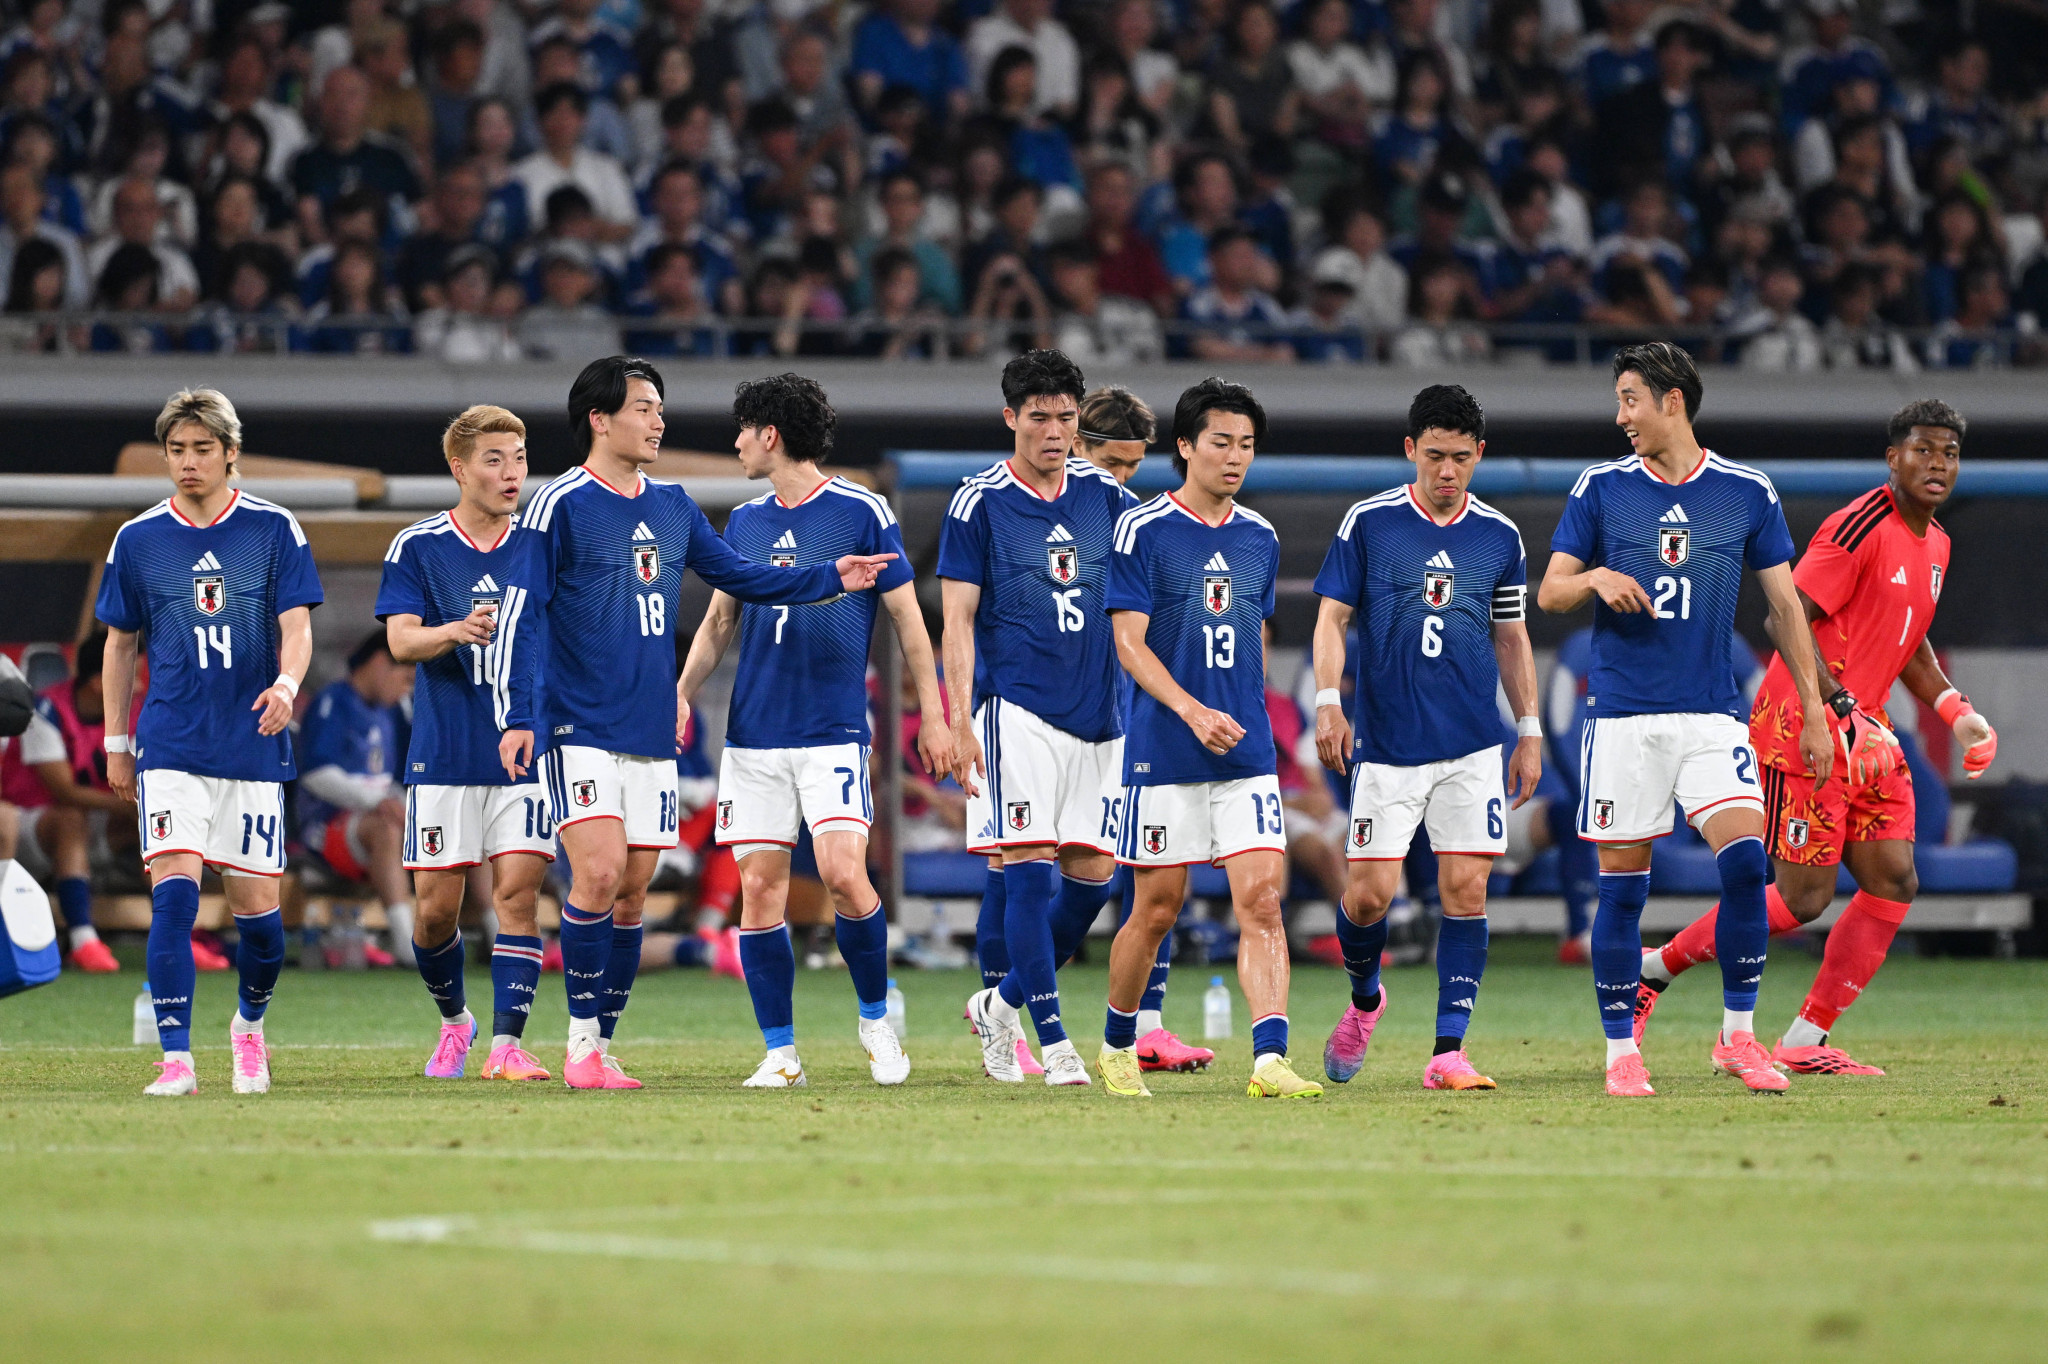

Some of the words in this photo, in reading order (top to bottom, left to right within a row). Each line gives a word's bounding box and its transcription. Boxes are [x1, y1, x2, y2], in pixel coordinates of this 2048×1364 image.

[636, 592, 665, 637] 18
[1051, 589, 1084, 633] 15
[1653, 575, 1691, 620] 21
[772, 604, 789, 645] 7
[1421, 615, 1444, 658] 6
[1898, 605, 1913, 647] 1
[193, 625, 232, 670] 14
[1202, 624, 1236, 669] 13
[833, 766, 855, 805] 7
[523, 796, 552, 840] 10
[659, 789, 677, 833] 18
[1100, 796, 1122, 839] 15
[1250, 792, 1282, 835] 13
[1486, 797, 1503, 840] 6
[241, 812, 277, 858] 14
[152, 996, 188, 1005] JAPAN
[1596, 981, 1639, 991] JAPAN
